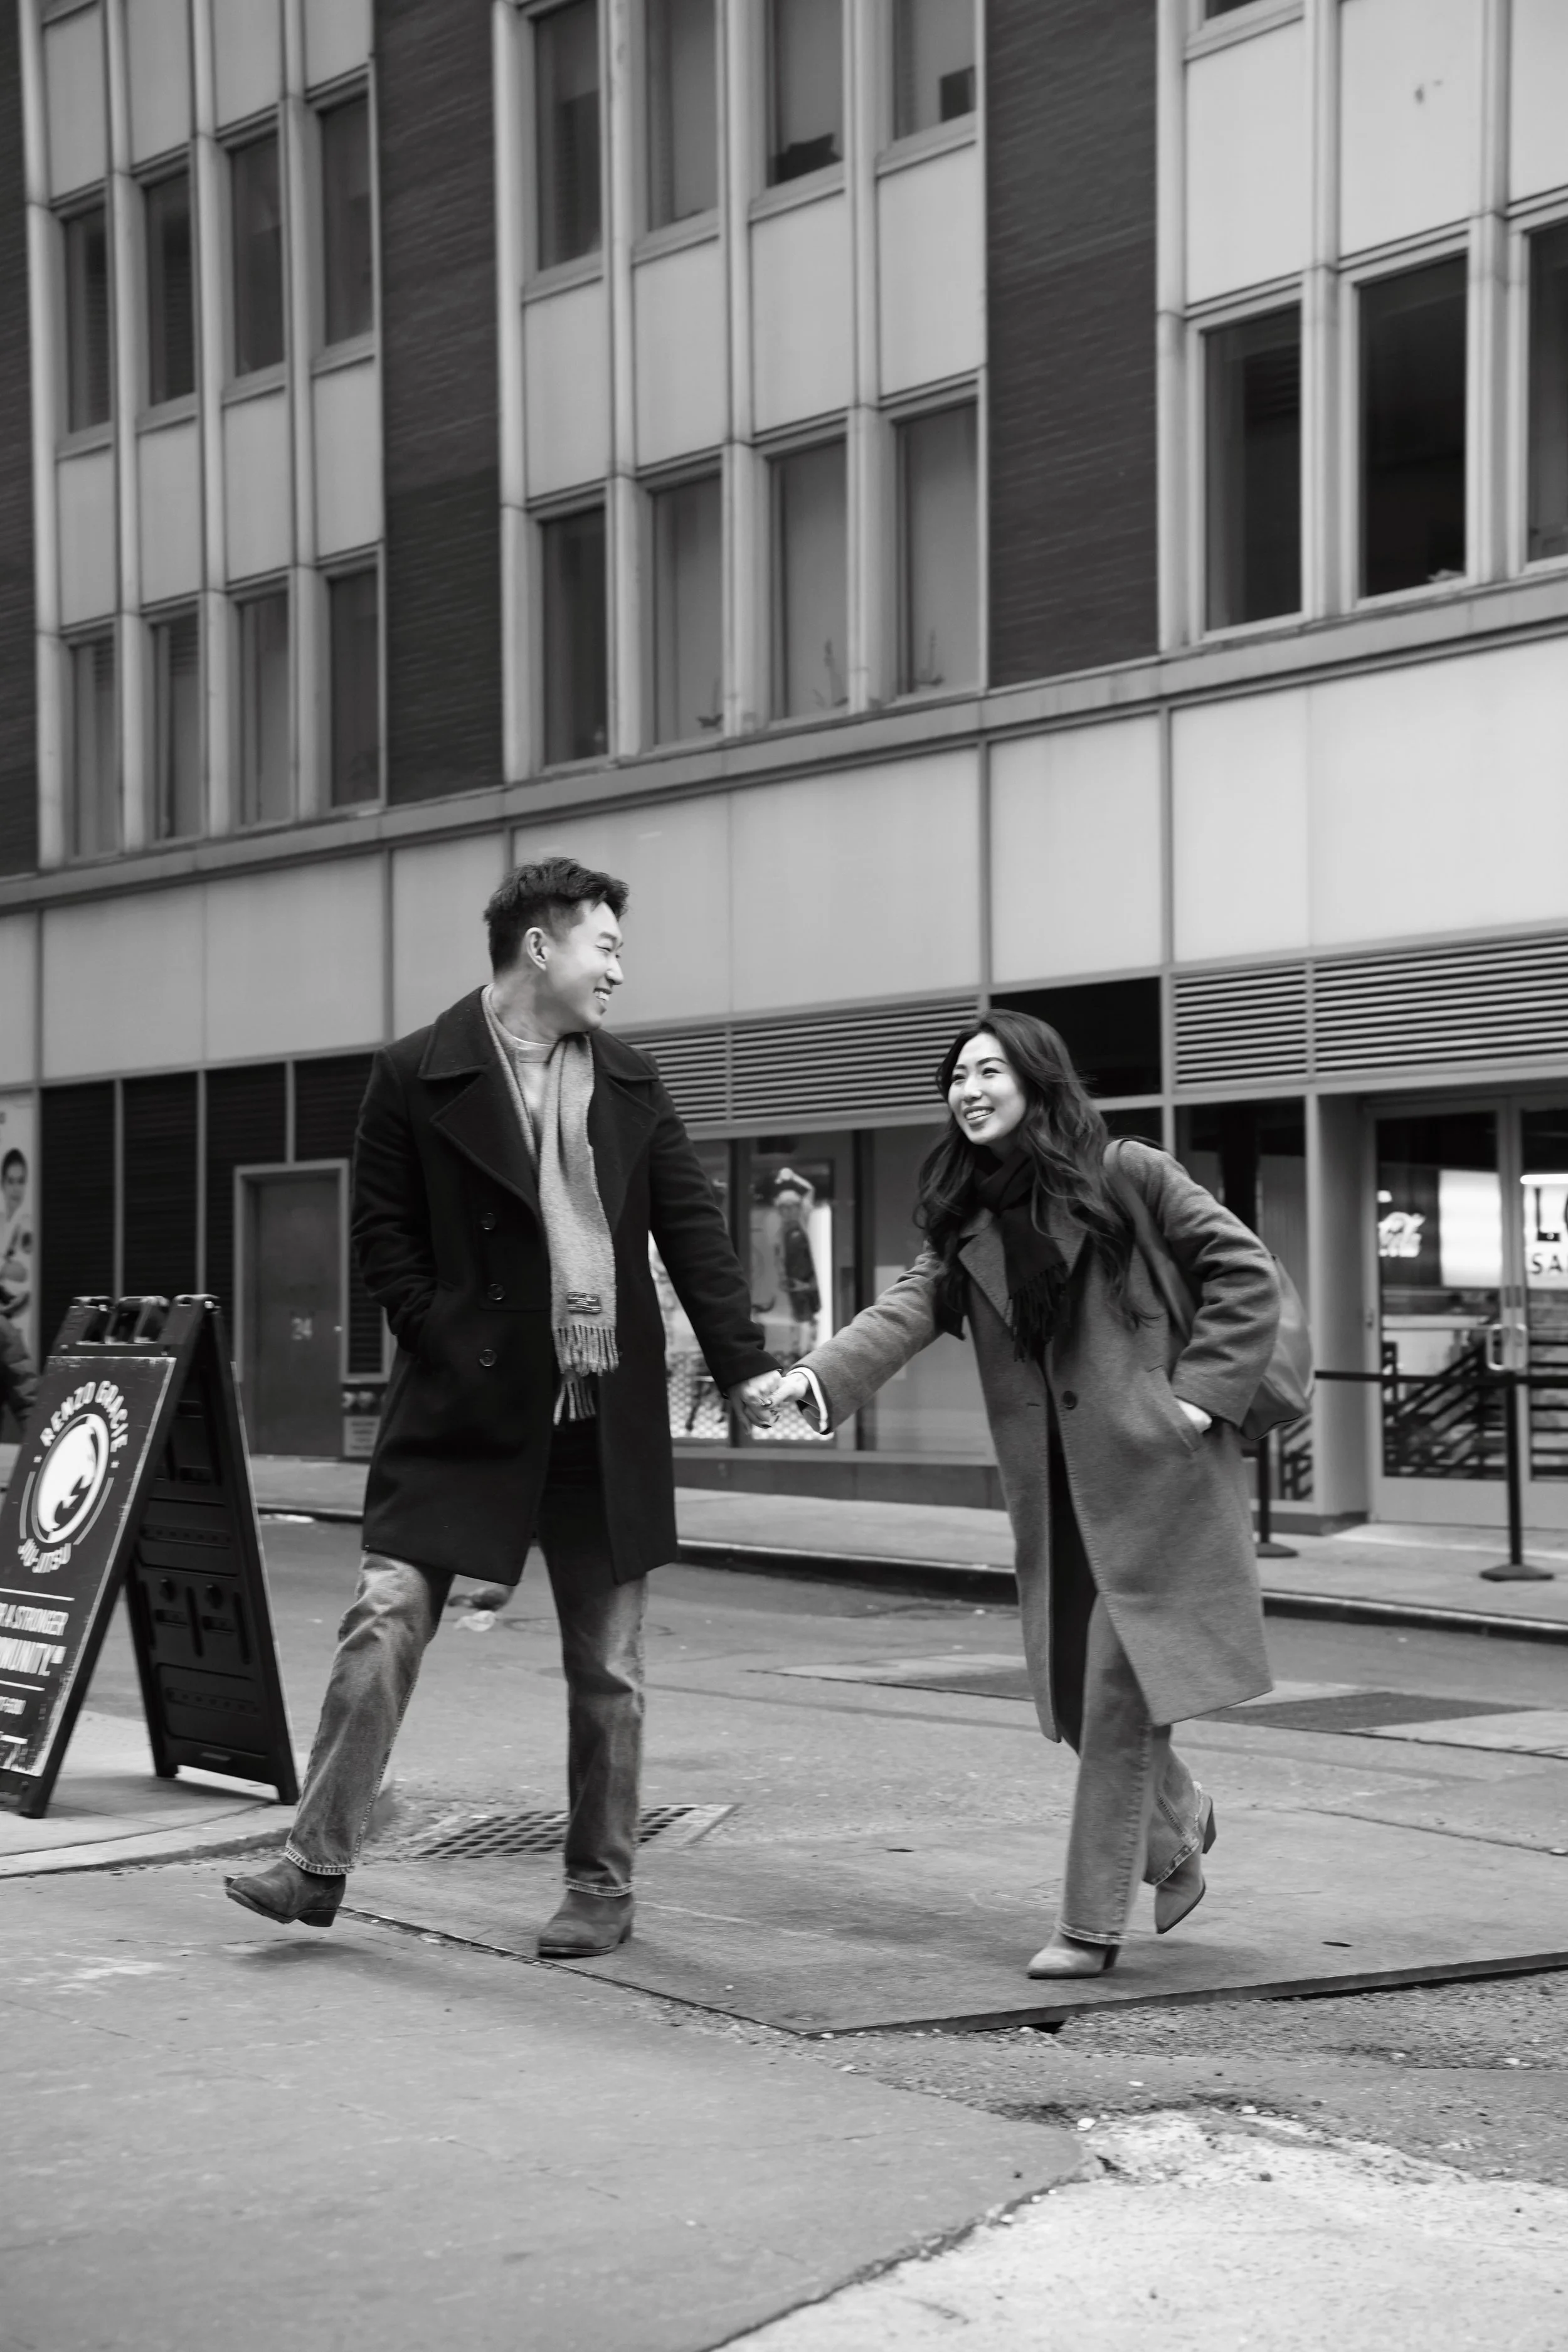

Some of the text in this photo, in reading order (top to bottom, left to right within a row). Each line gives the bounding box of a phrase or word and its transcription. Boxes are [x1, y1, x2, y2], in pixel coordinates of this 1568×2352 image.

[40, 1380, 129, 1453] RENZO GRACIE
[18, 1538, 72, 1573] JIU-JITSU
[12, 1606, 69, 1636] STRONGER
